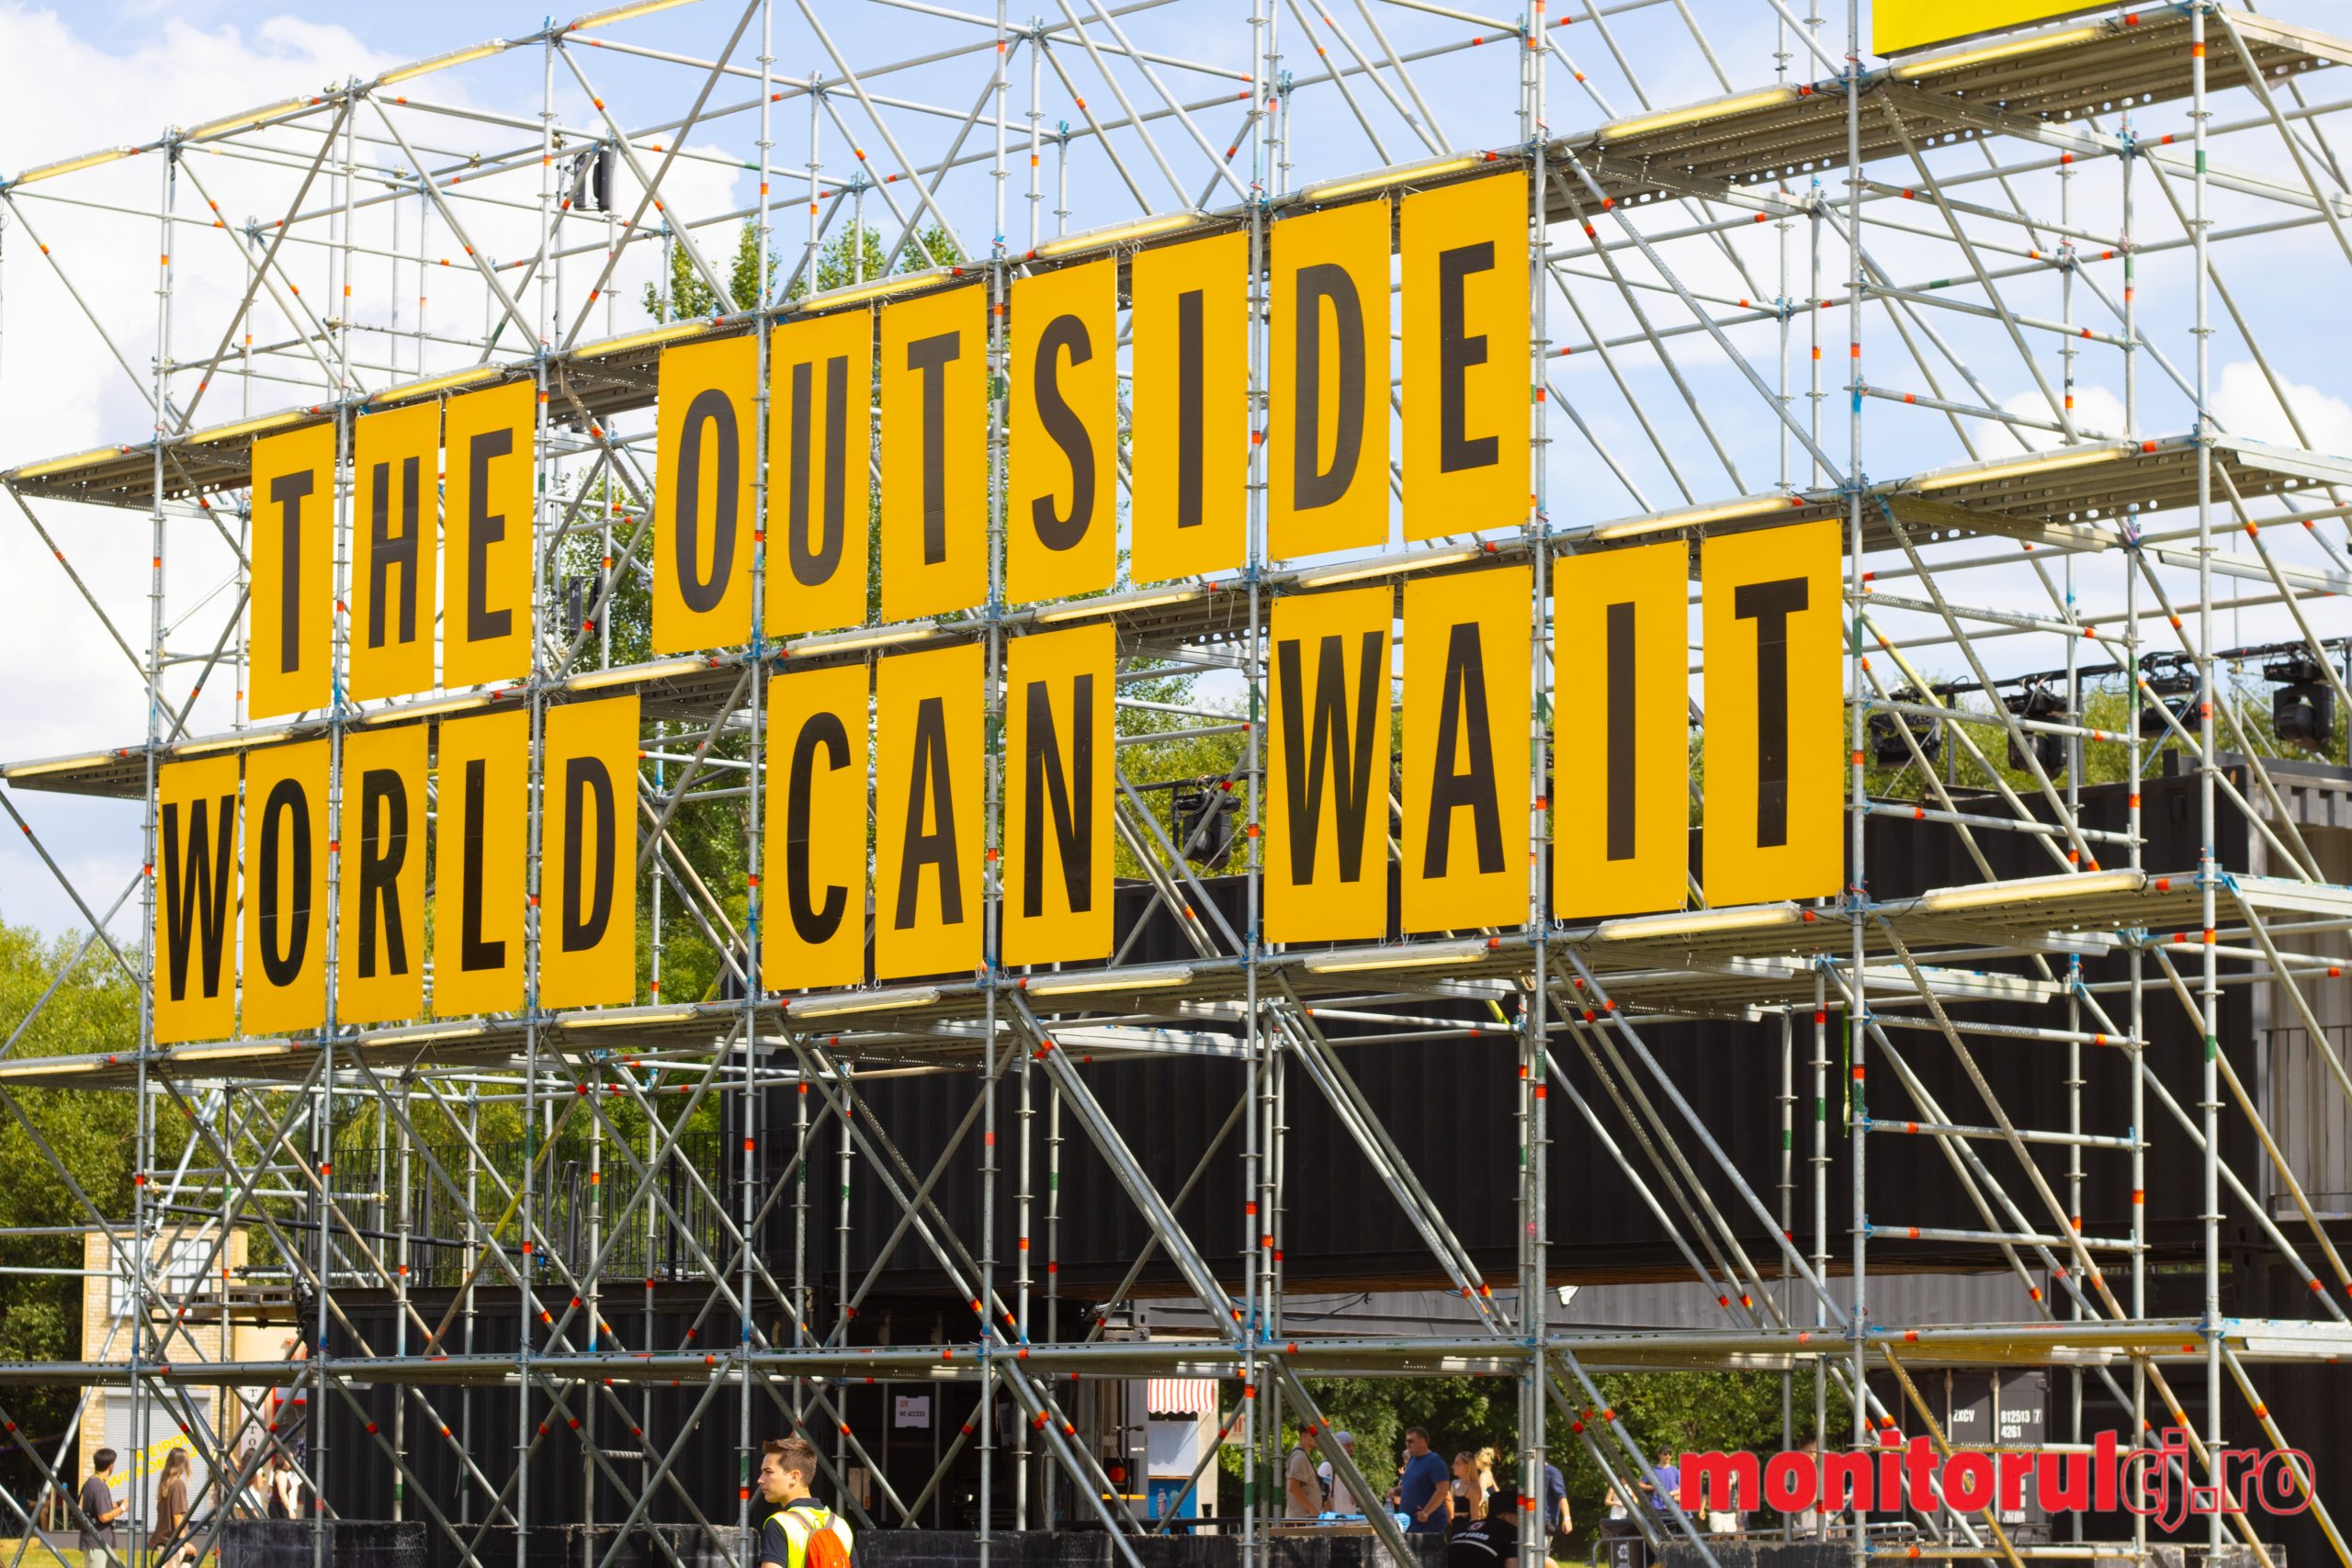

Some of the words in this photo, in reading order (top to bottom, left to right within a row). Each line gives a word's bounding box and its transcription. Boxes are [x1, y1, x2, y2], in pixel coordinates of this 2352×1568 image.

[272, 429, 512, 672] THE
[675, 241, 1498, 613] OUTSIDE
[163, 757, 616, 1001] WORLD
[786, 673, 1093, 944] CAN
[1279, 576, 1809, 886] WAIT
[2000, 1410, 2030, 1424] 812513
